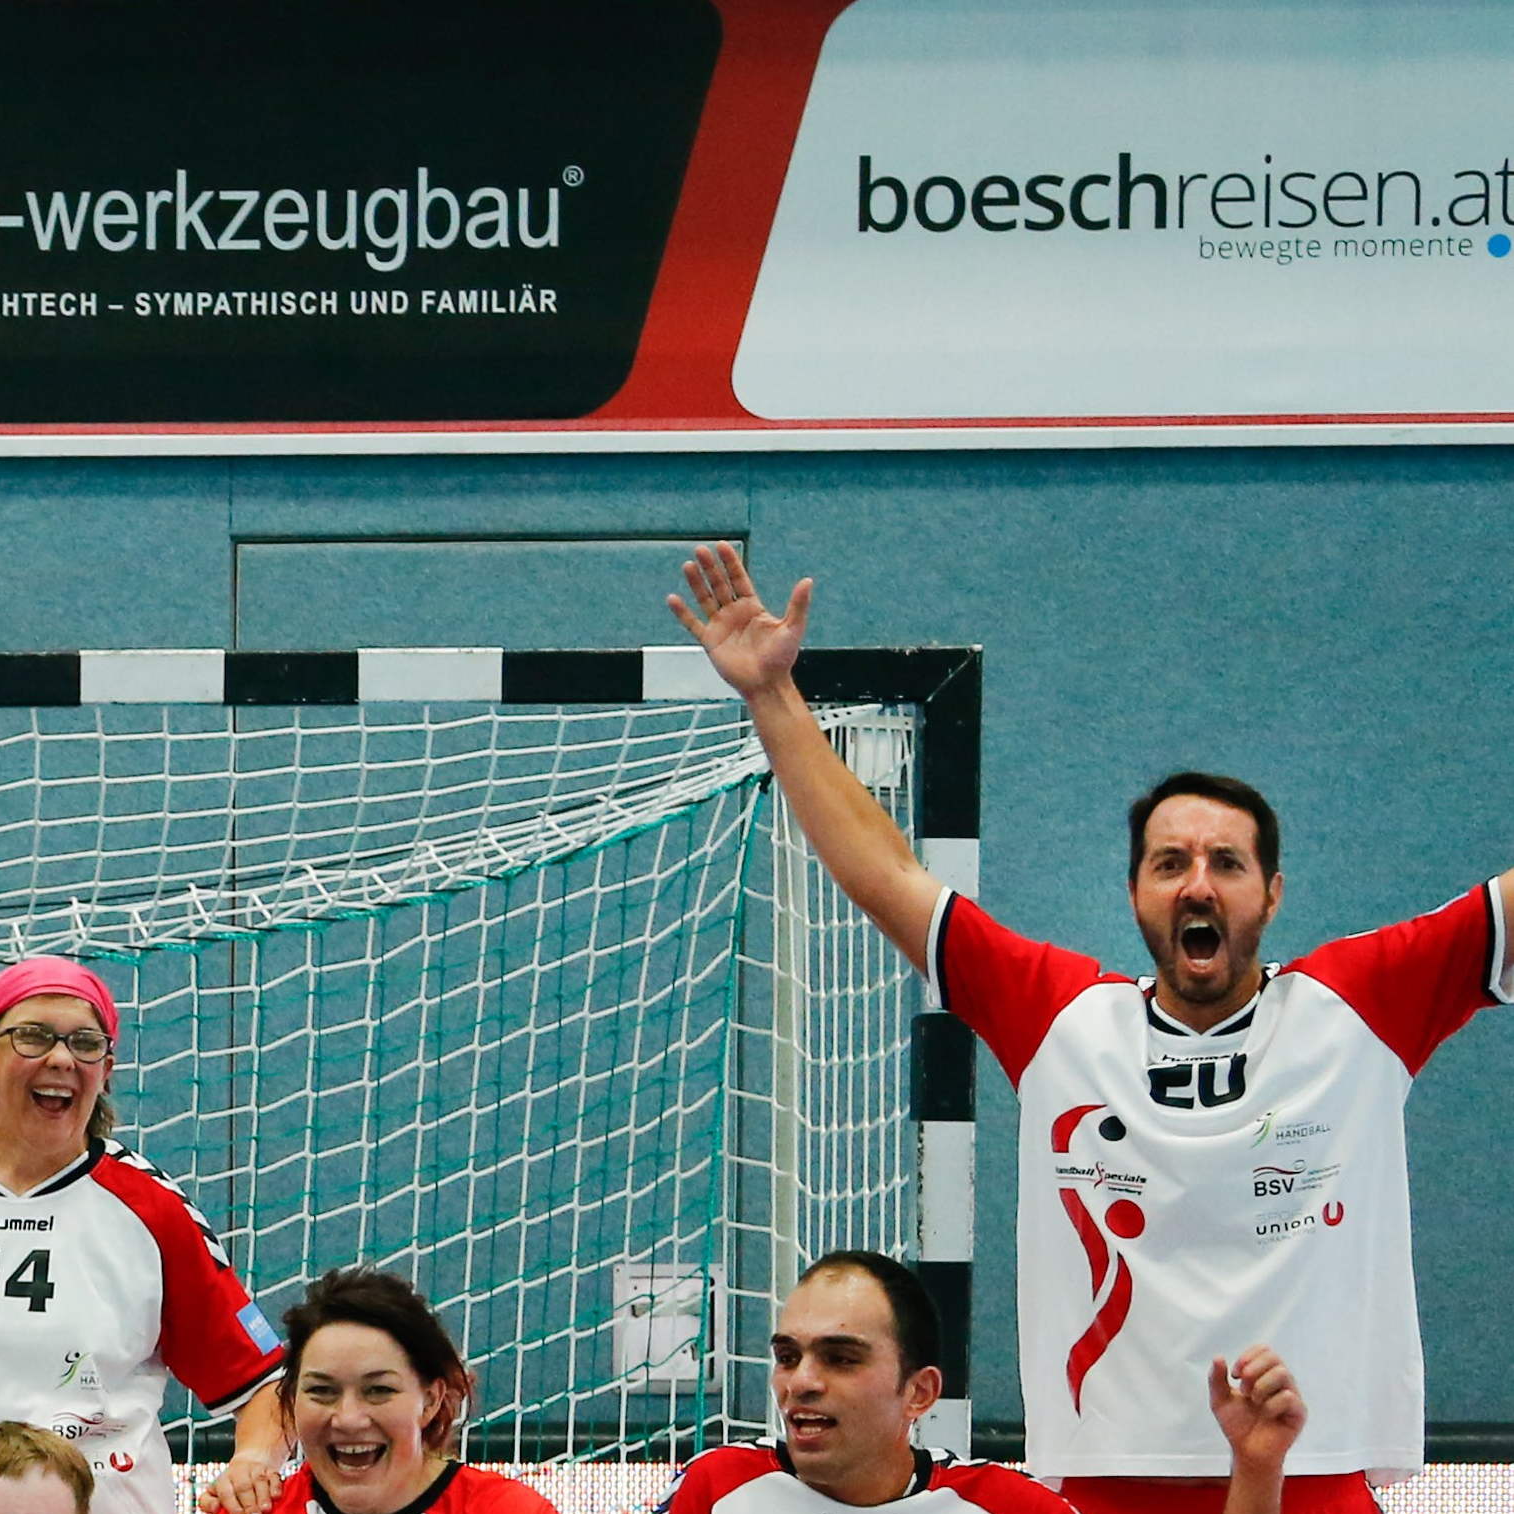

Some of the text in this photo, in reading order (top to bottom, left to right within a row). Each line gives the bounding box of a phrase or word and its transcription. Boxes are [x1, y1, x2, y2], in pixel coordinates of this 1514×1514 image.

[1198, 234, 1474, 266] bewegte momente
[134, 290, 338, 317] SYMPATHISCH
[349, 289, 409, 316] UND
[420, 284, 558, 315] FAMILIÄR
[1254, 1177, 1295, 1197] BSV
[1256, 1214, 1315, 1236] union
